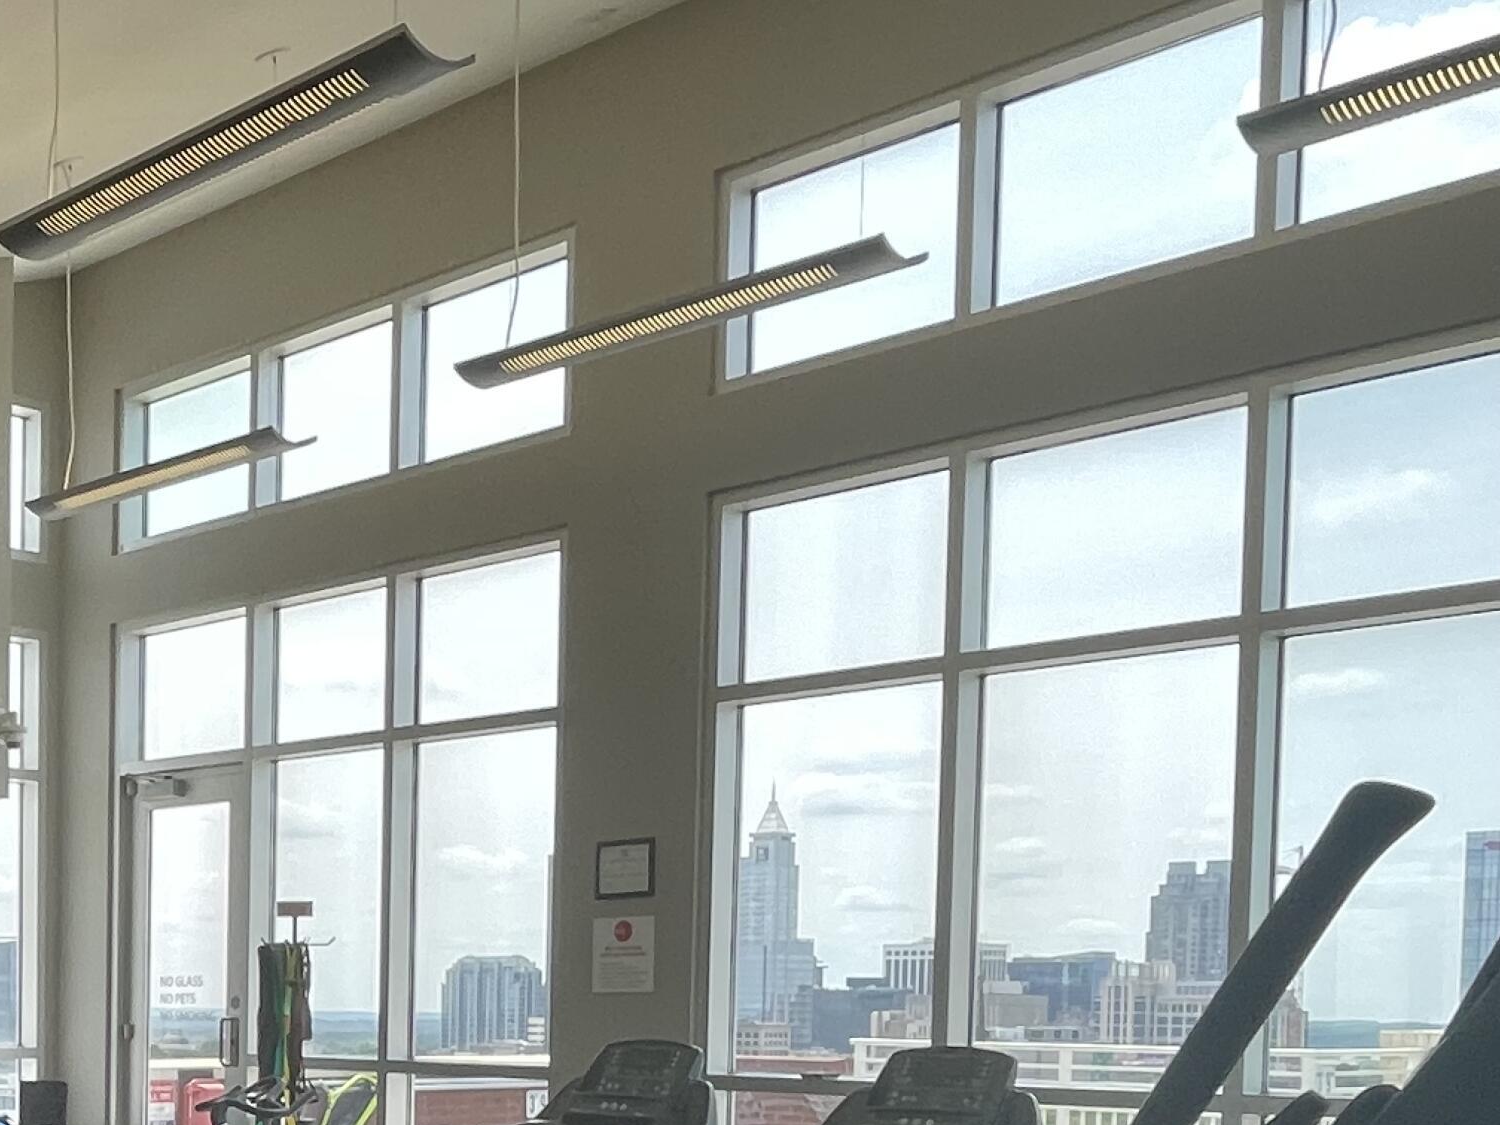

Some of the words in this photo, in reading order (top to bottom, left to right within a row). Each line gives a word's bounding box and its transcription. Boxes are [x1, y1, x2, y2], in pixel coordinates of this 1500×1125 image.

[159, 975, 173, 987] NO
[174, 975, 204, 988] GLASS
[160, 993, 174, 1005] NO
[175, 992, 197, 1005] PETS
